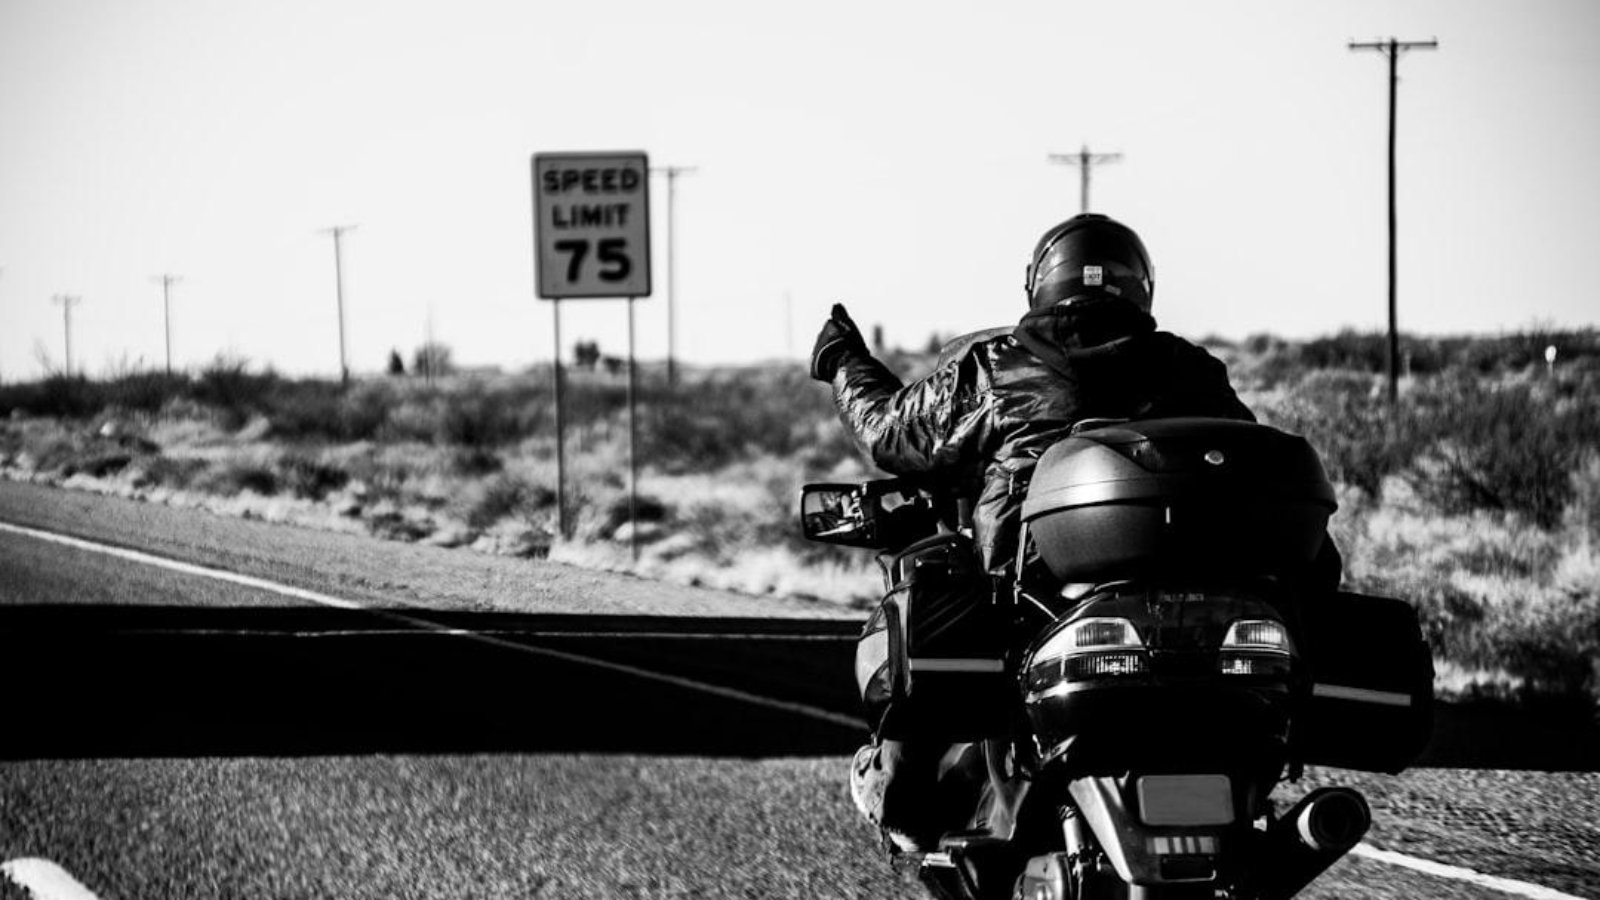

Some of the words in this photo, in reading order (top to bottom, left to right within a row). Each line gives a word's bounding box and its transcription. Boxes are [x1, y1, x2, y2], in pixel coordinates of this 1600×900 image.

[543, 168, 639, 193] SPEED
[552, 203, 629, 228] LIMIT
[554, 238, 631, 283] 75
